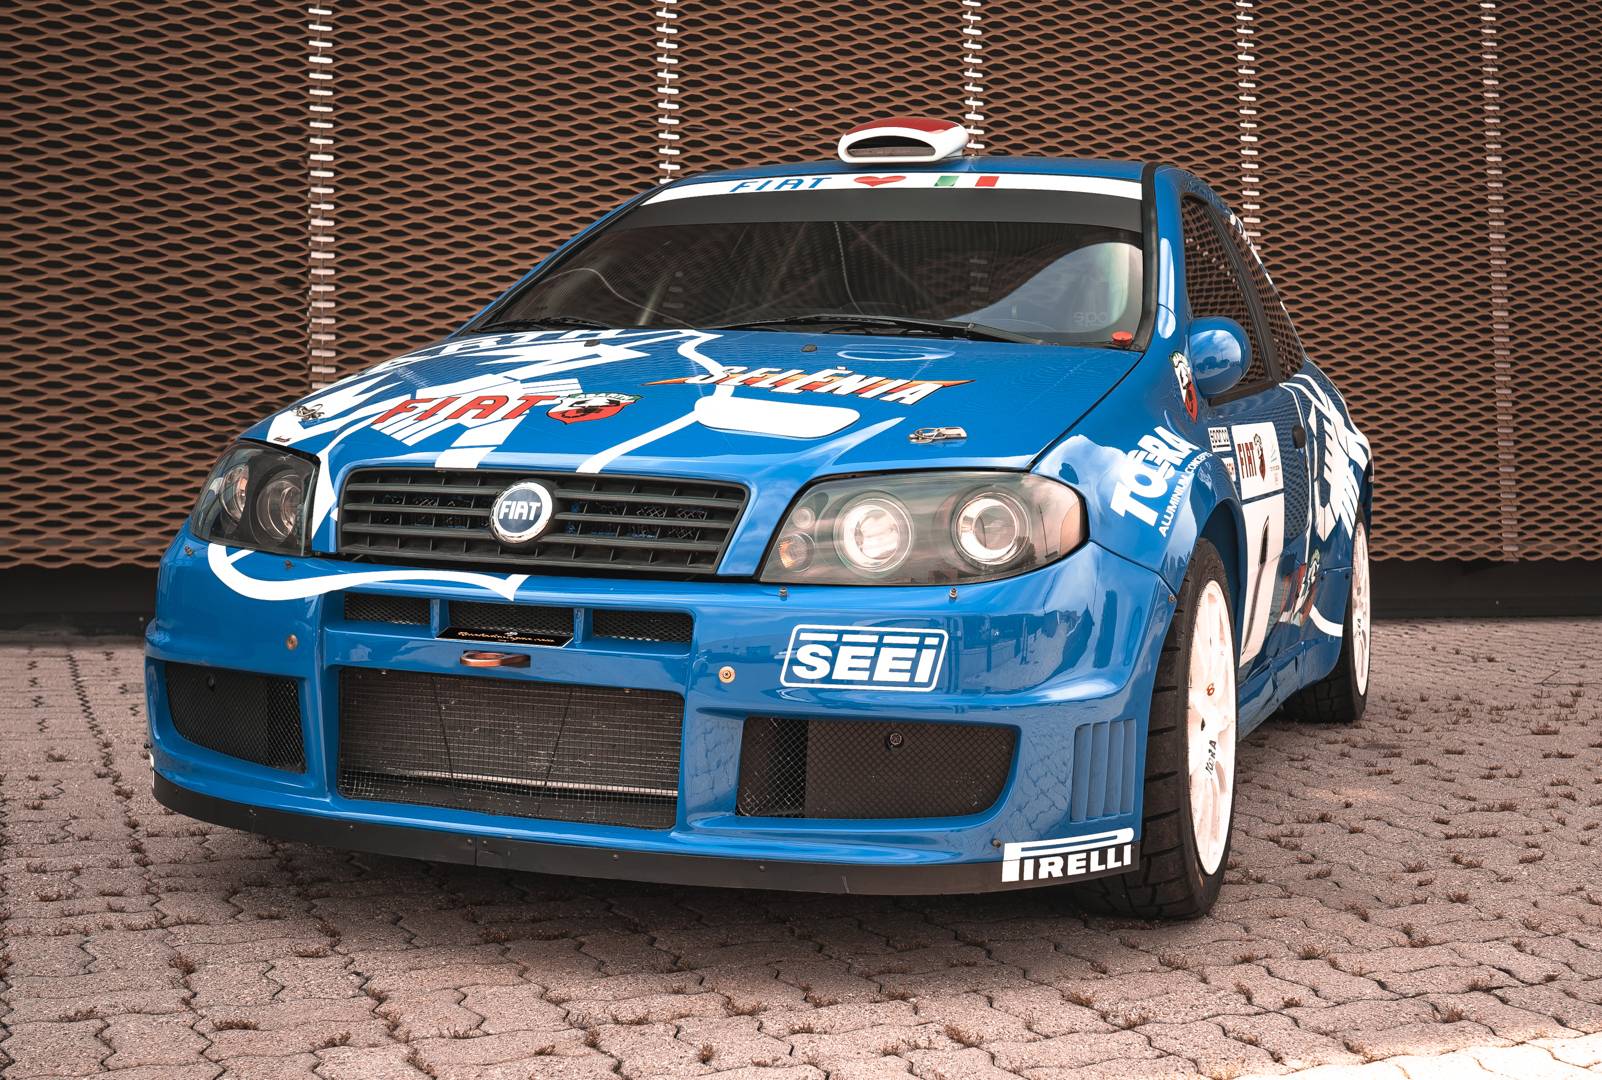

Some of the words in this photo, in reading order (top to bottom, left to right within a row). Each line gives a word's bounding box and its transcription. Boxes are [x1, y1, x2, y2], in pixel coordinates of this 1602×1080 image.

[729, 176, 833, 193] FIAT
[371, 395, 561, 425] FIAT
[1237, 442, 1257, 479] FIAT
[499, 500, 541, 521] FIAT
[1001, 827, 1135, 882] PIRELLI
